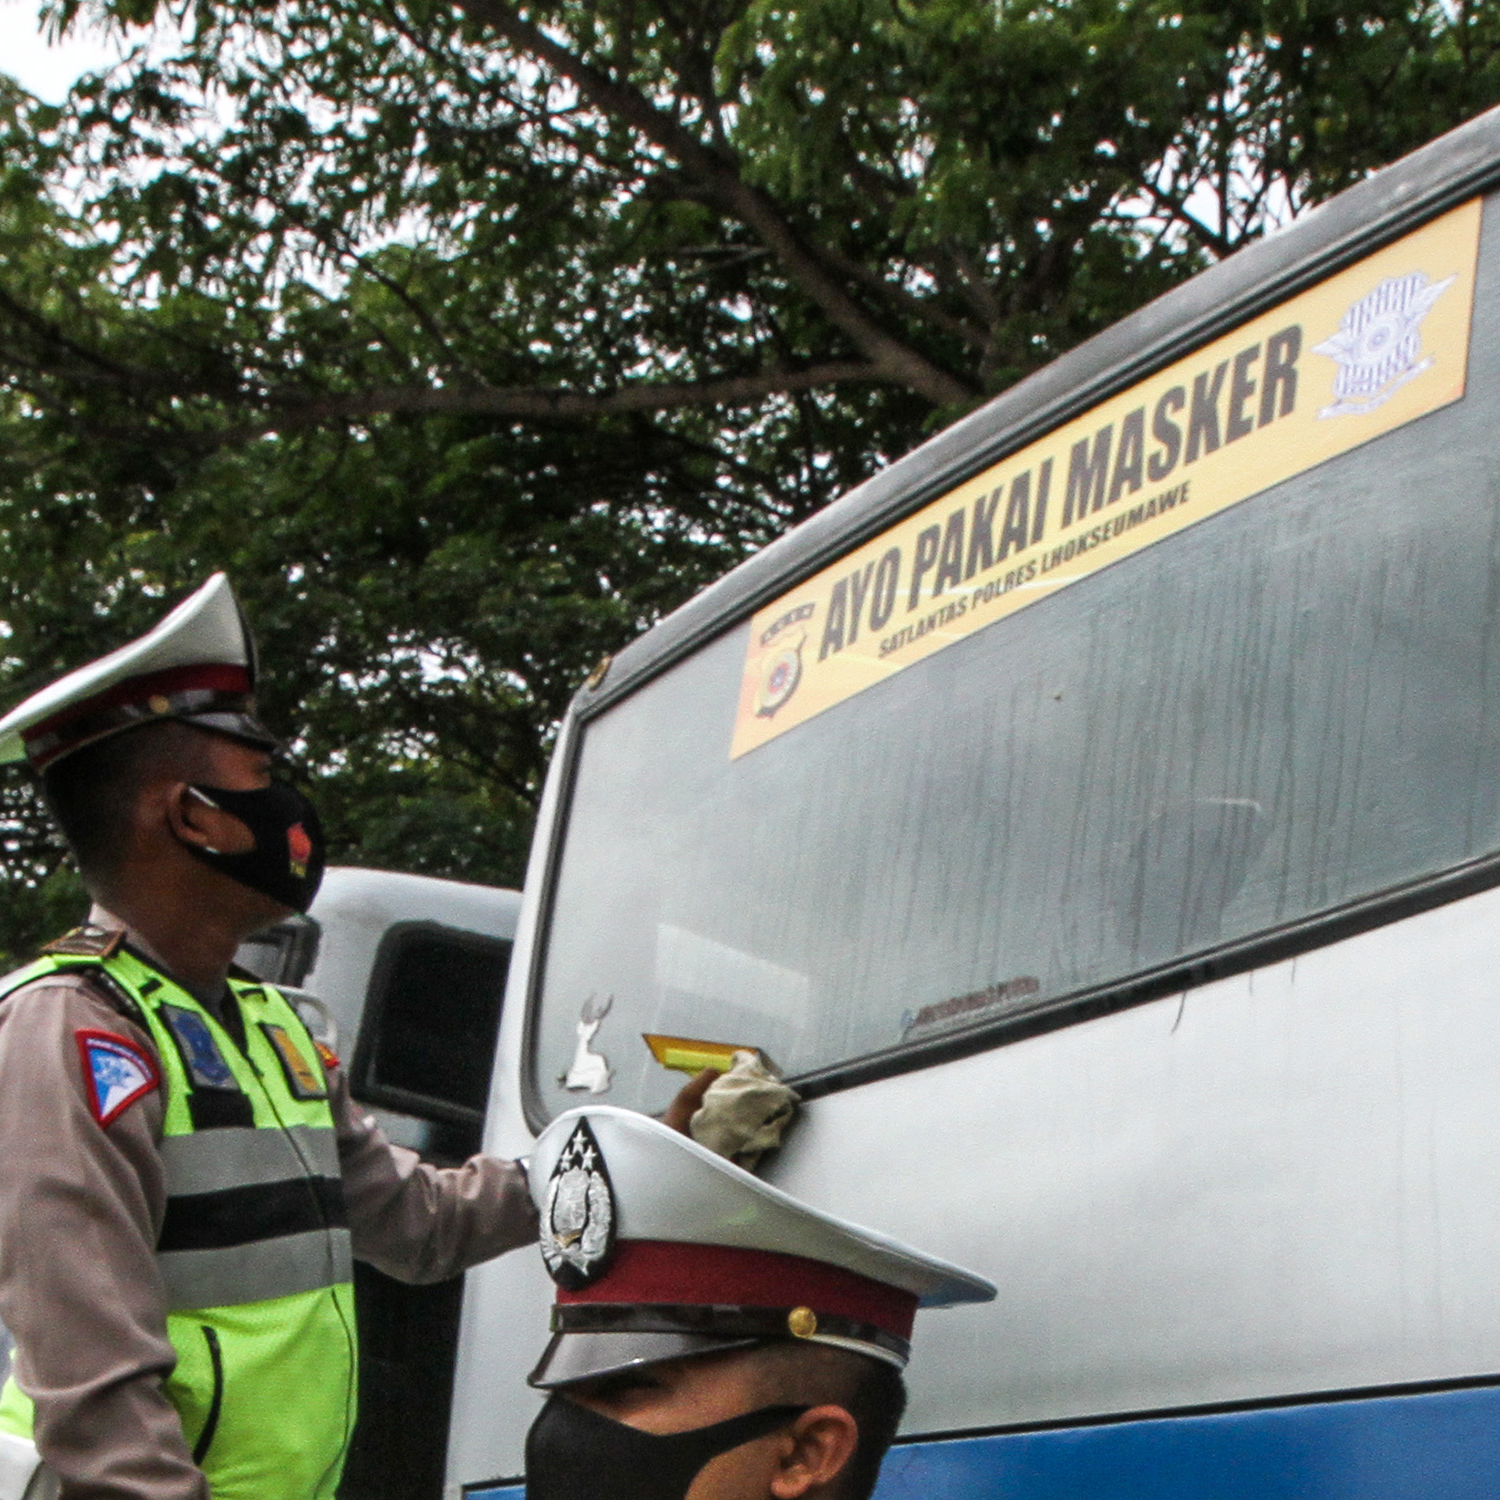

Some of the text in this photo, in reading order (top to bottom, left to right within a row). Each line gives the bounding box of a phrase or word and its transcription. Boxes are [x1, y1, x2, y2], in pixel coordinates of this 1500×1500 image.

[818, 323, 1303, 663] AYO PAKAI MASKER
[878, 594, 967, 658] SATLANTAS
[971, 558, 1037, 611] POLRES
[1040, 480, 1192, 574] LHOKSEUMAWE
